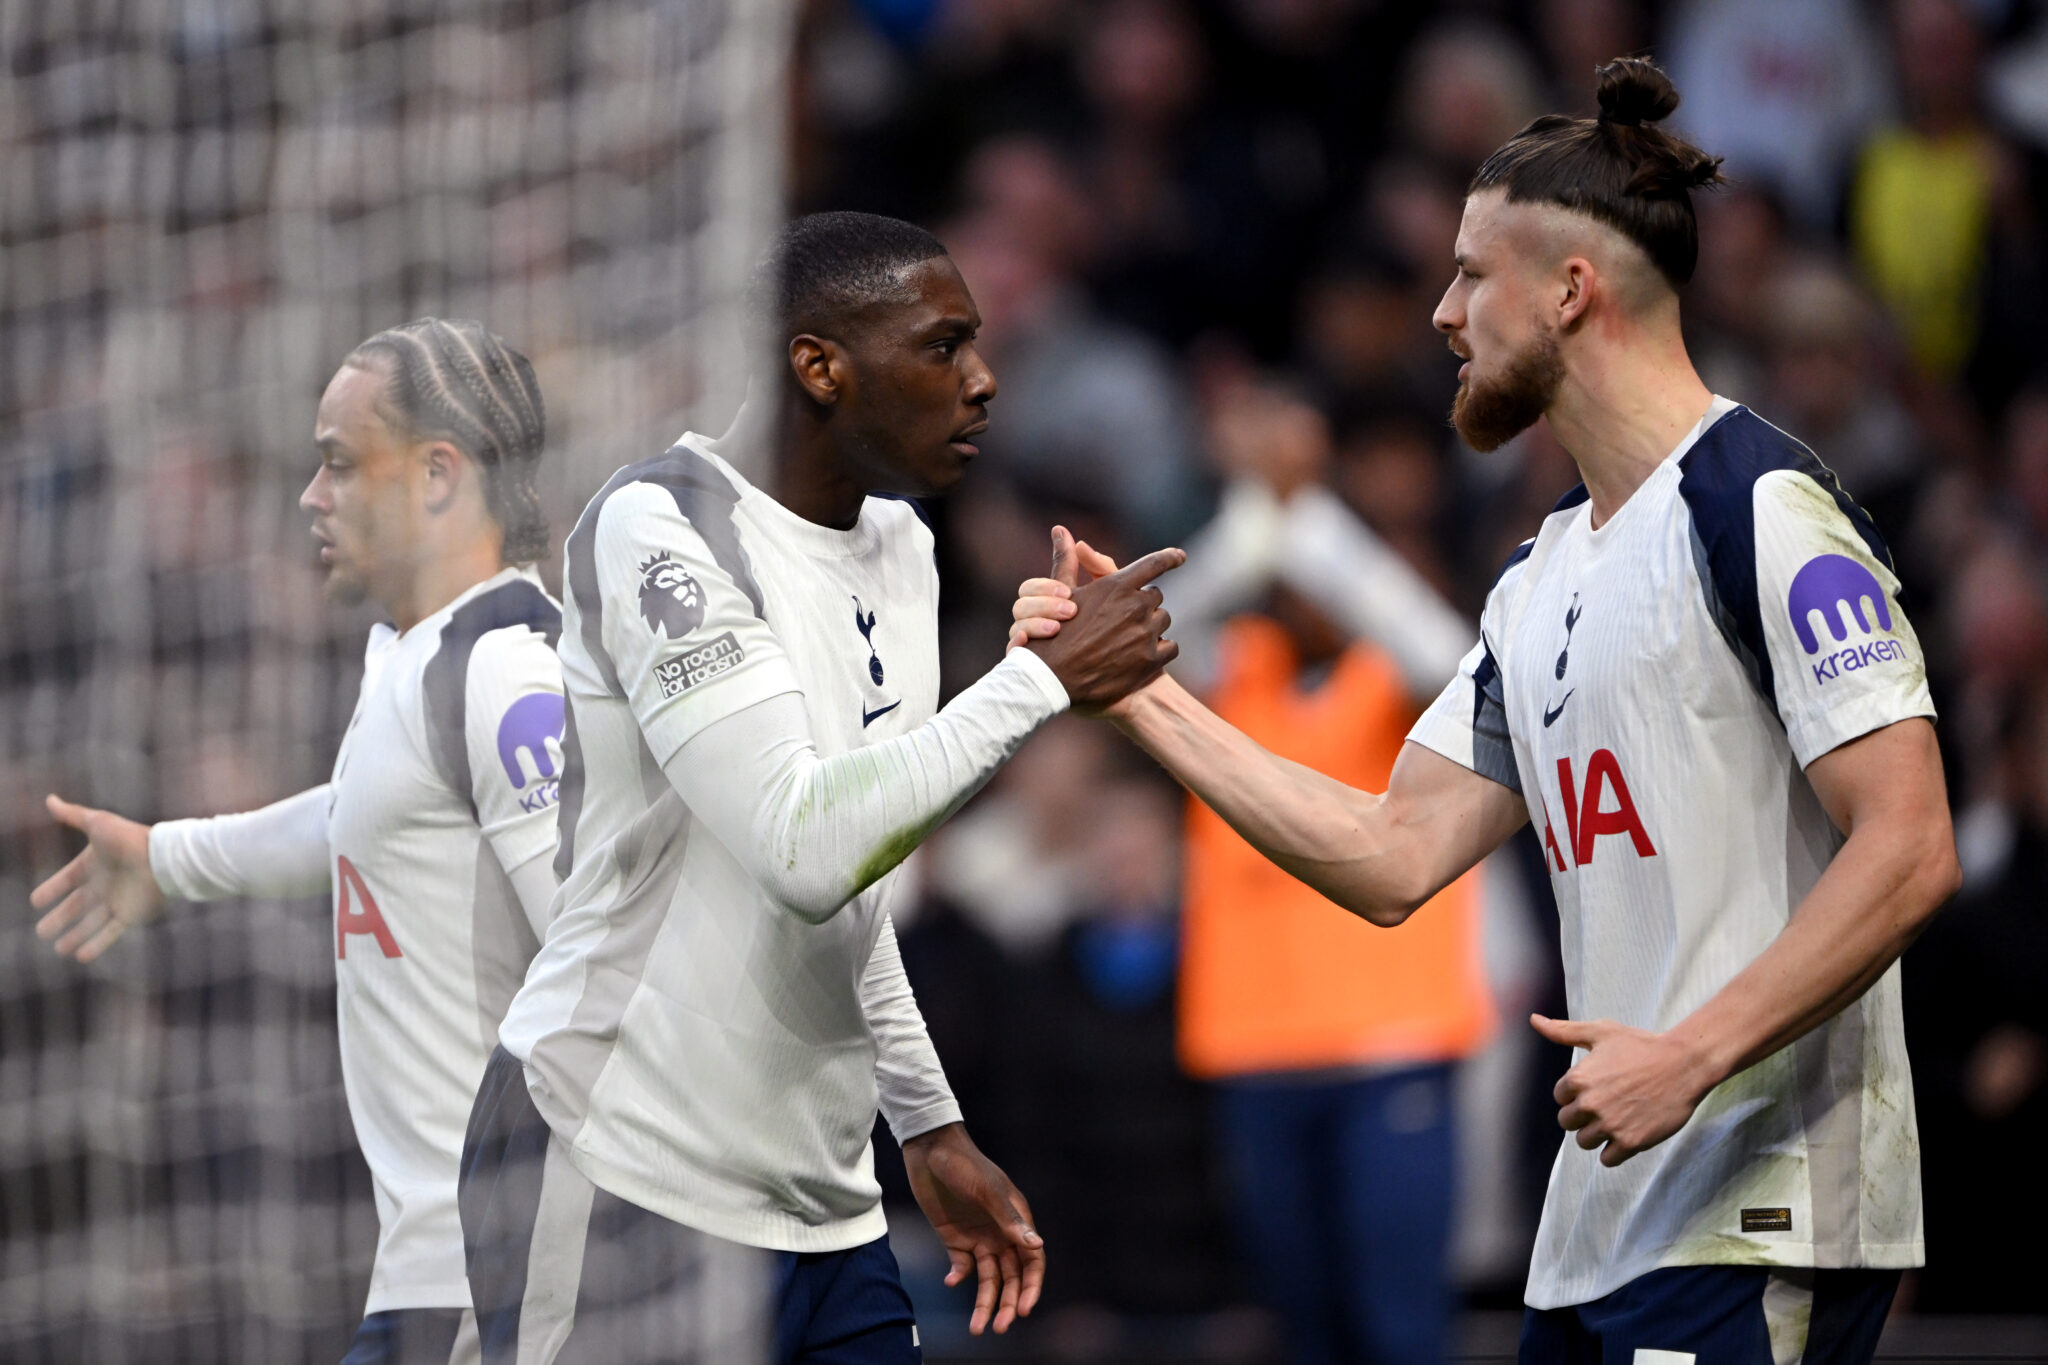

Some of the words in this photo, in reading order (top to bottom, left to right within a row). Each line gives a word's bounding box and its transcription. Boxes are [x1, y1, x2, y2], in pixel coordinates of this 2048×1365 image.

[653, 662, 682, 683] No
[682, 639, 732, 671] room
[660, 675, 685, 698] for
[686, 649, 744, 685] racism
[1812, 640, 1906, 685] kraken
